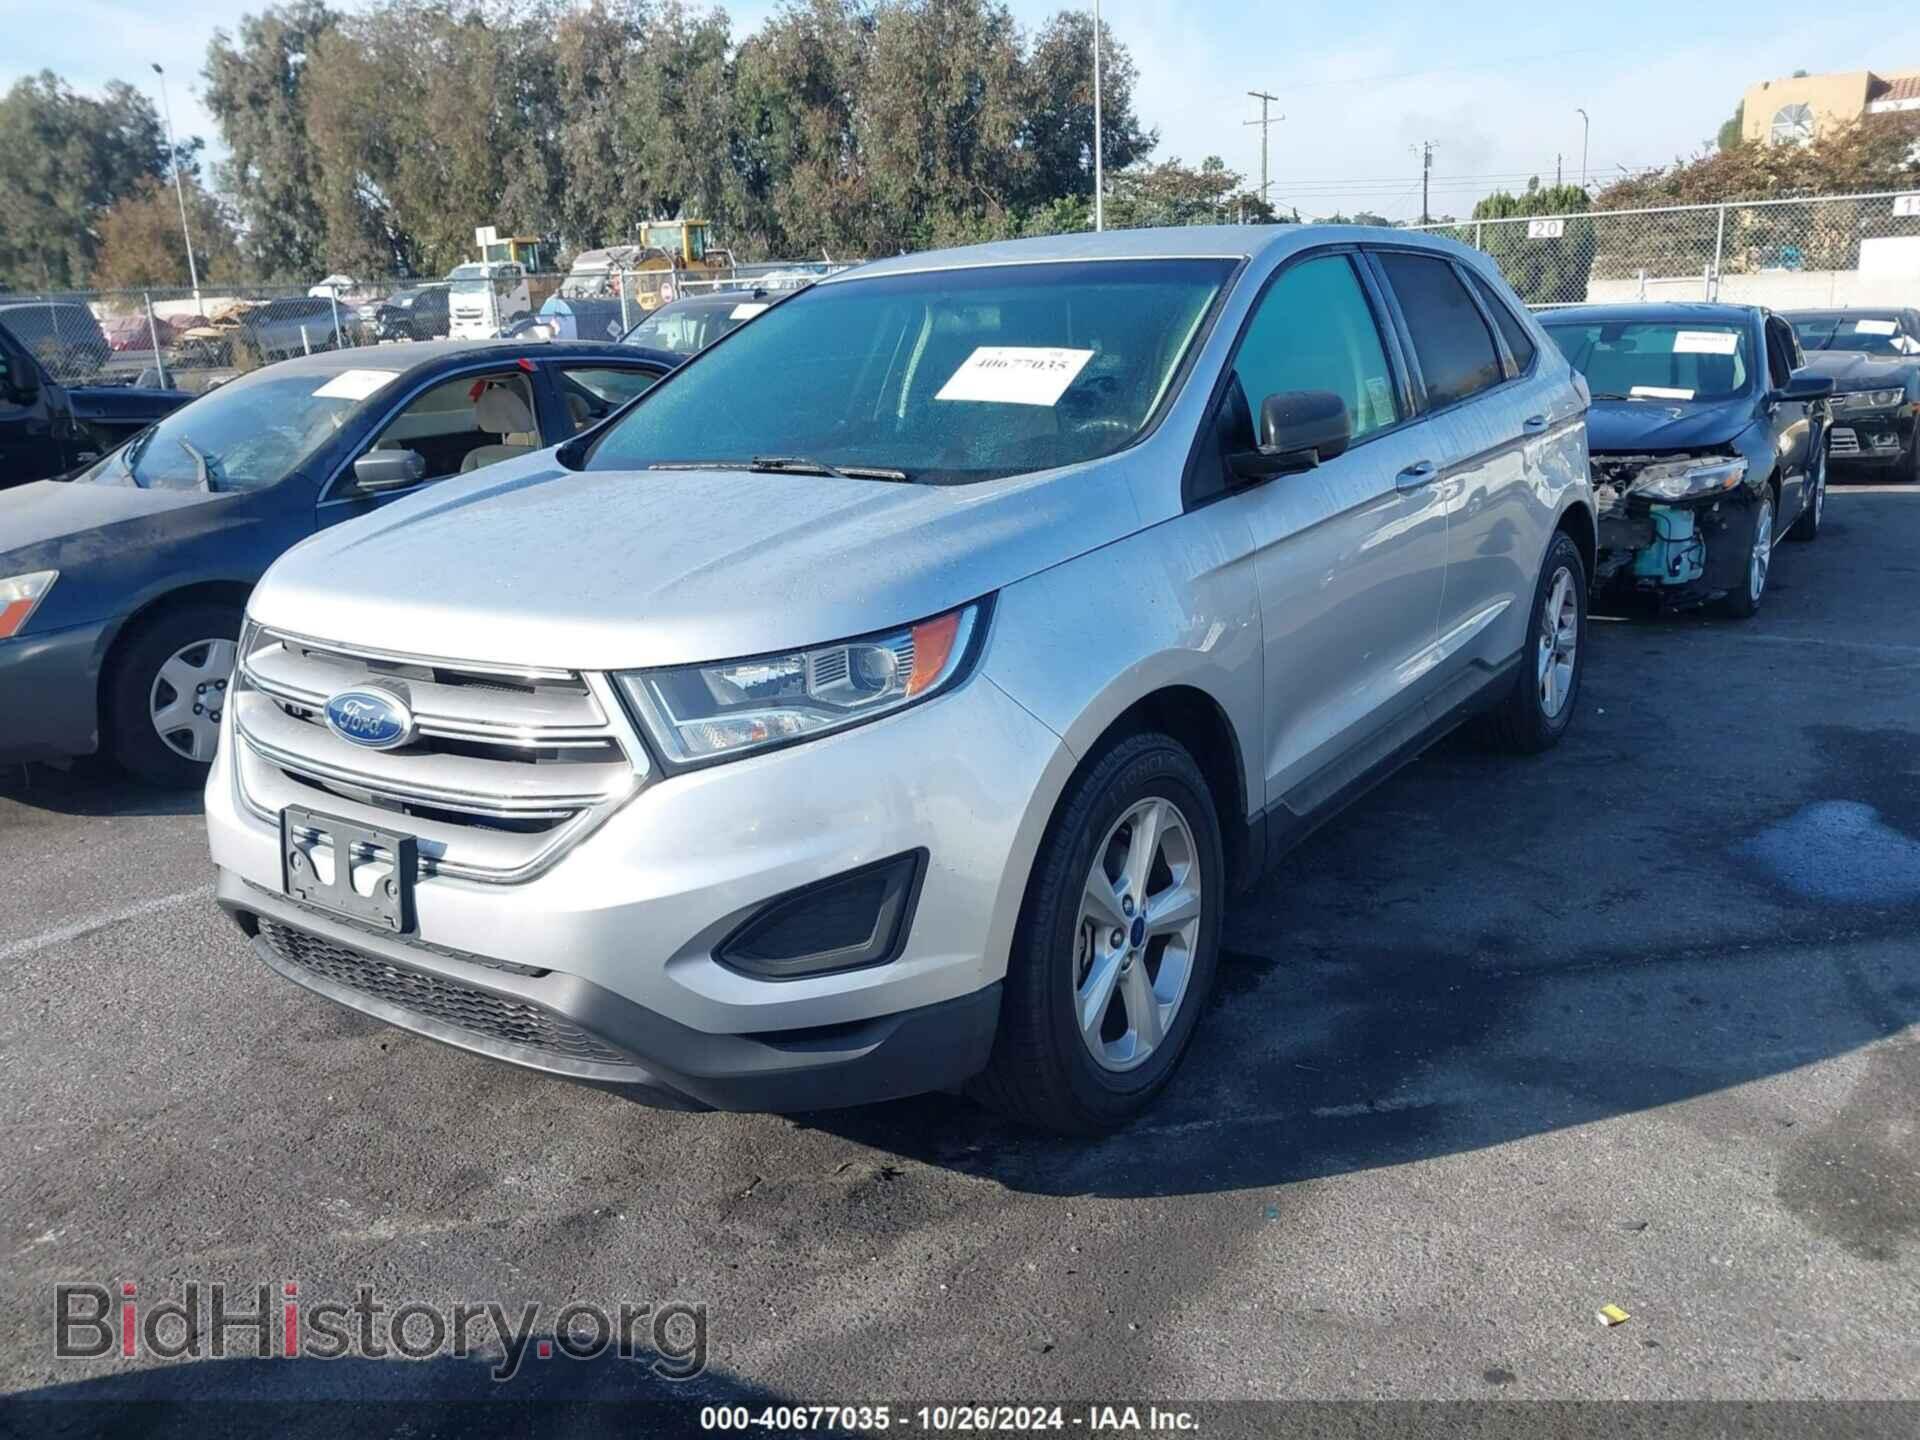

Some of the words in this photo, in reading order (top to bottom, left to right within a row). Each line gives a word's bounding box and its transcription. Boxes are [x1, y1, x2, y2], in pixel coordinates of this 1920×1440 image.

[1904, 198, 1920, 214] 1
[1535, 222, 1558, 236] 20
[338, 700, 385, 736] Ford
